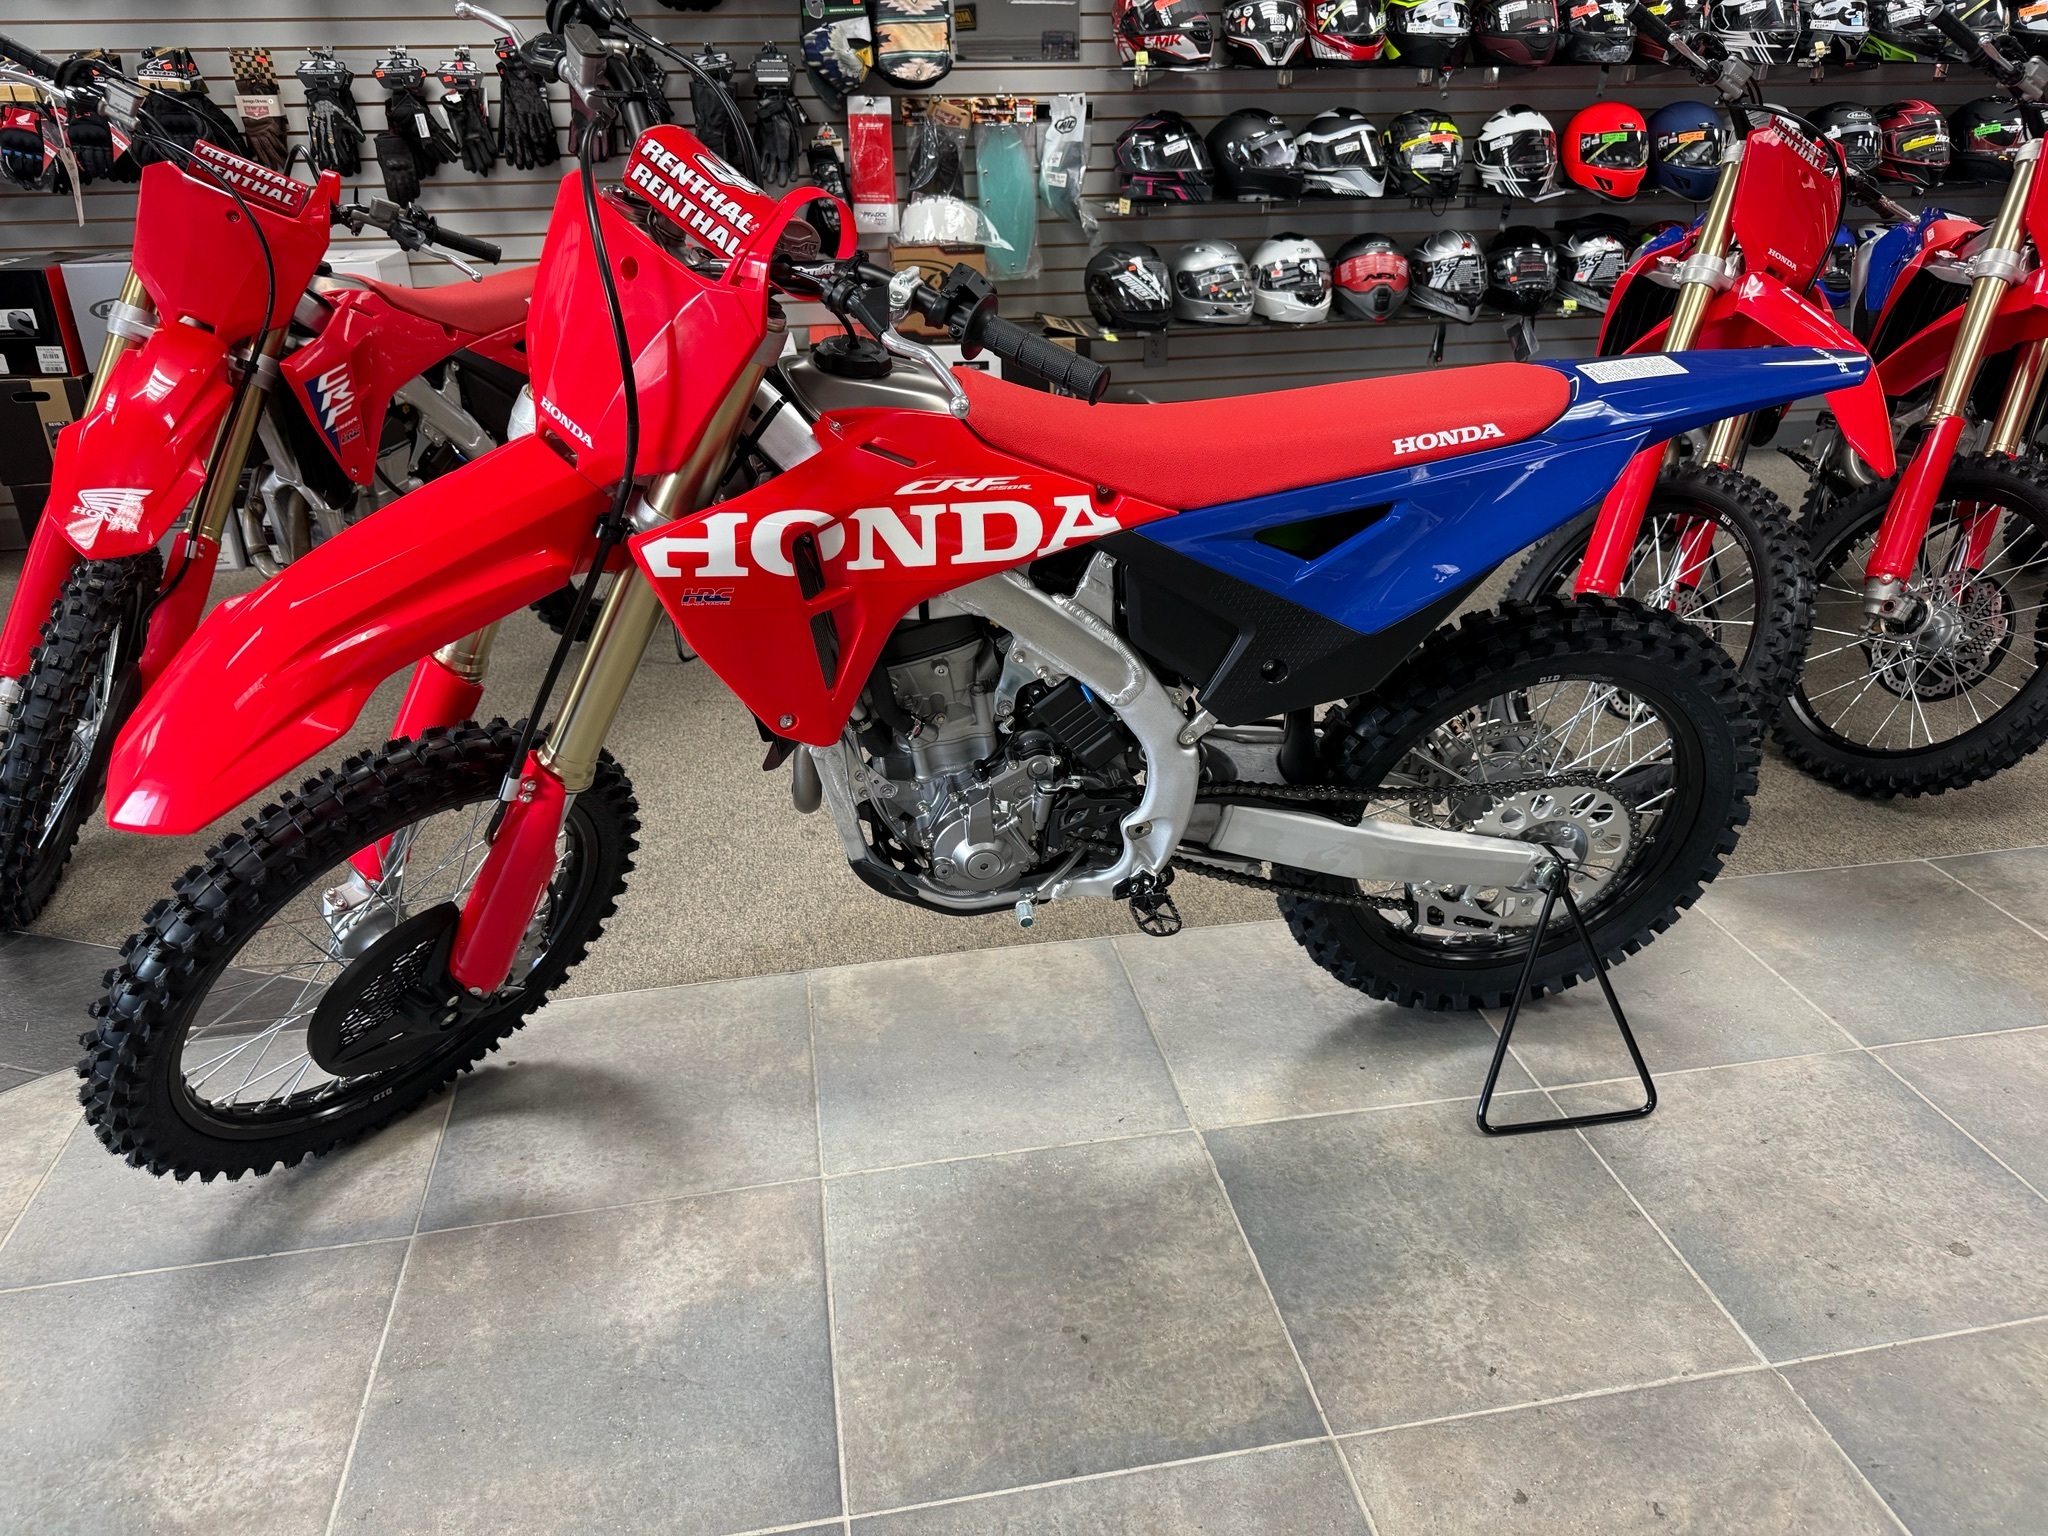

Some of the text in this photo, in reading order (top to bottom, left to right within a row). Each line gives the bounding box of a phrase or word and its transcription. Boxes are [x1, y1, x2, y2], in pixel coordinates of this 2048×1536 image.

[1143, 34, 1182, 49] SMK
[200, 145, 299, 193] RENTHAL
[1772, 125, 1820, 170] RENTHAL
[641, 138, 754, 236] RENTHAL
[630, 162, 743, 259] RENTHAL
[1767, 248, 1797, 272] HONDA
[317, 362, 355, 431] CRF
[540, 395, 594, 449] HONDA
[1391, 422, 1506, 456] HONDA
[894, 475, 1033, 496] CRF 250R
[71, 505, 140, 534] HONDA
[641, 494, 1123, 578] HONDA
[681, 587, 735, 603] HRC
